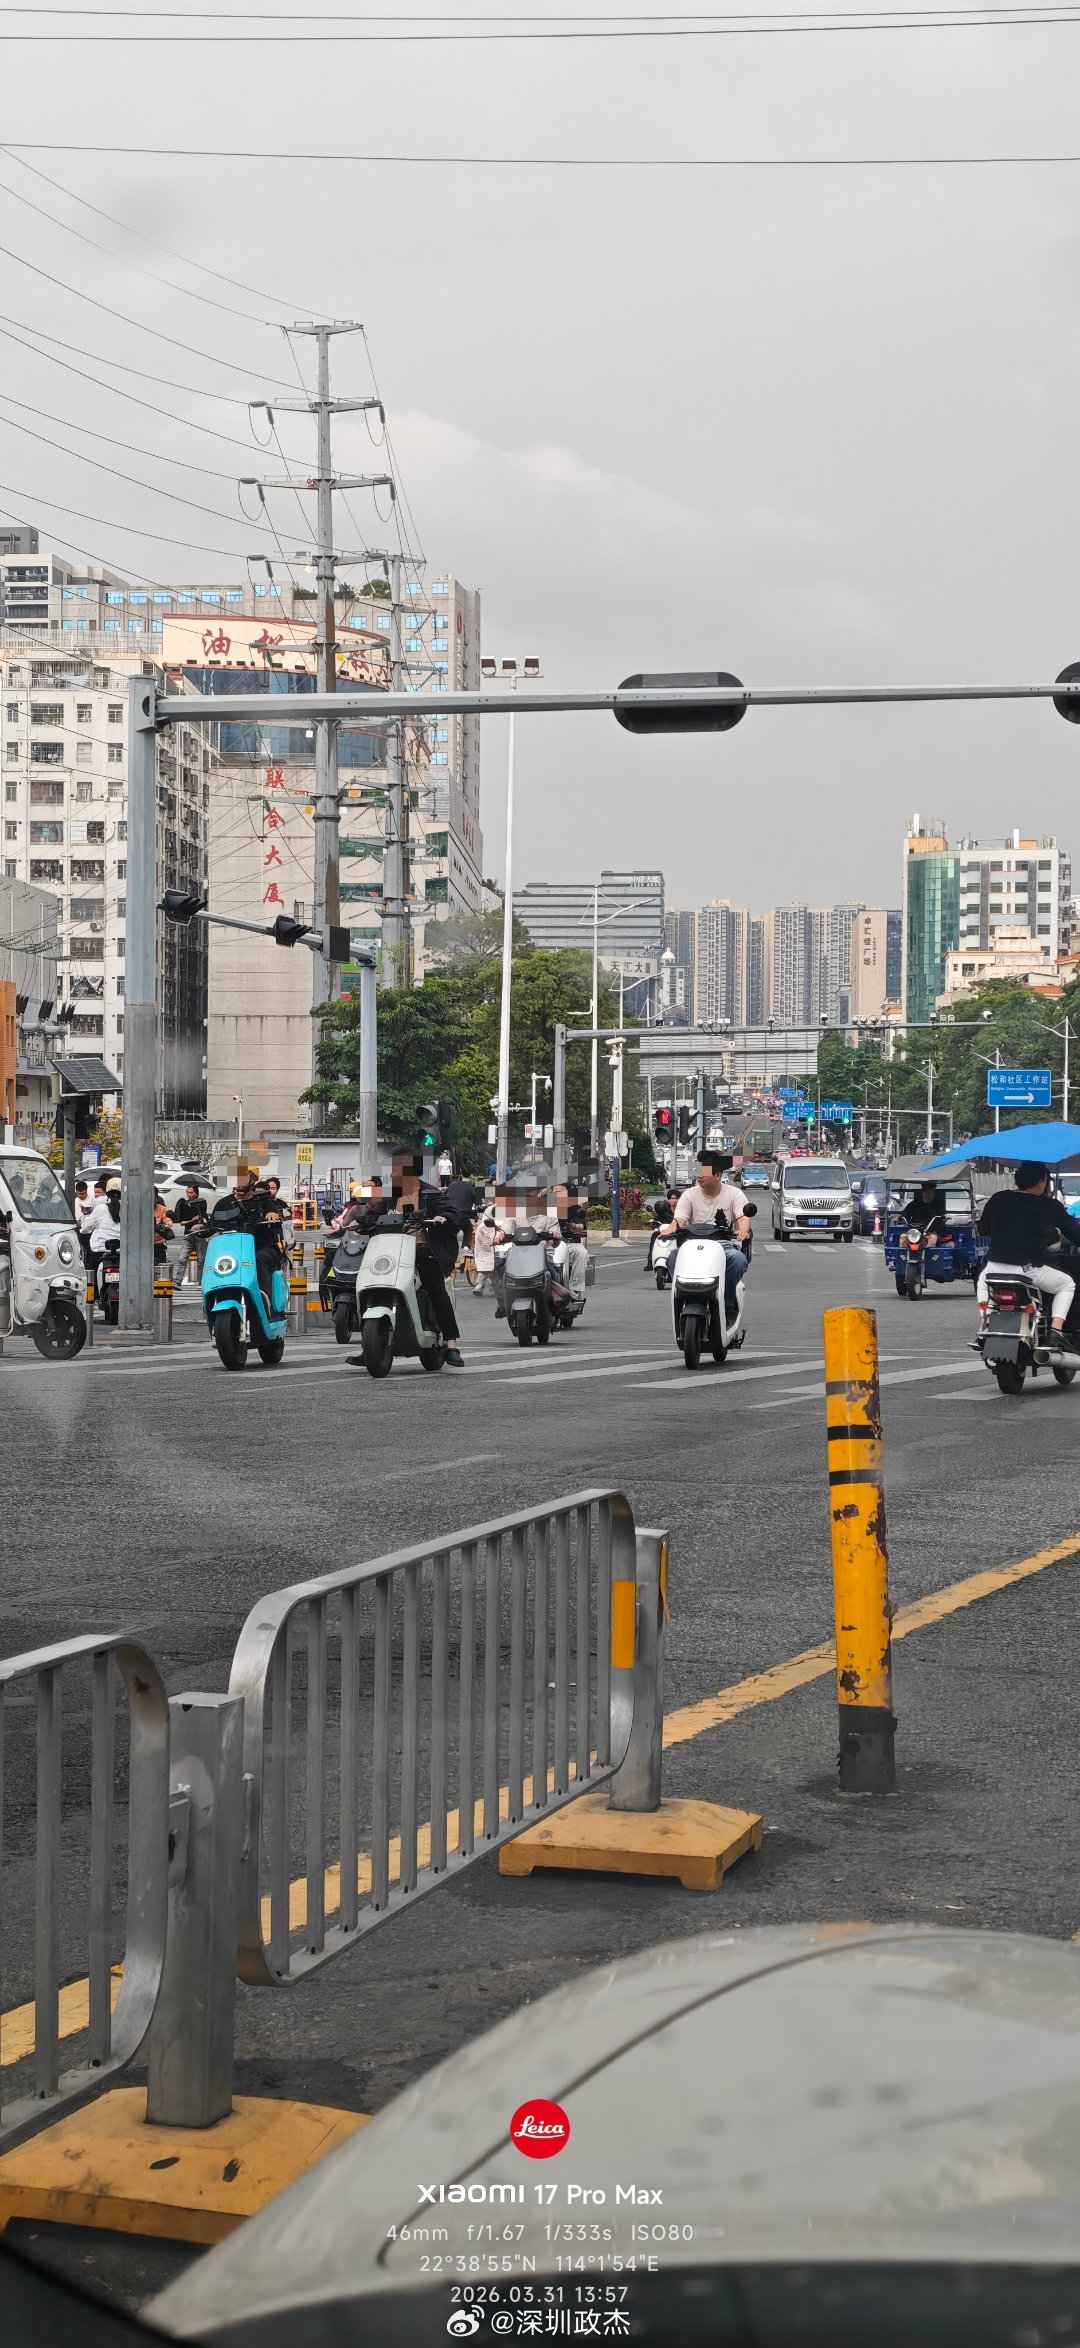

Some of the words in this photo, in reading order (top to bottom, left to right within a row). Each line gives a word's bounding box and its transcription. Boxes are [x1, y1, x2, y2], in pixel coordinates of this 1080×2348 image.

[263, 767, 286, 911] 联合大厦
[990, 1074, 1049, 1085] 松和社区工作站
